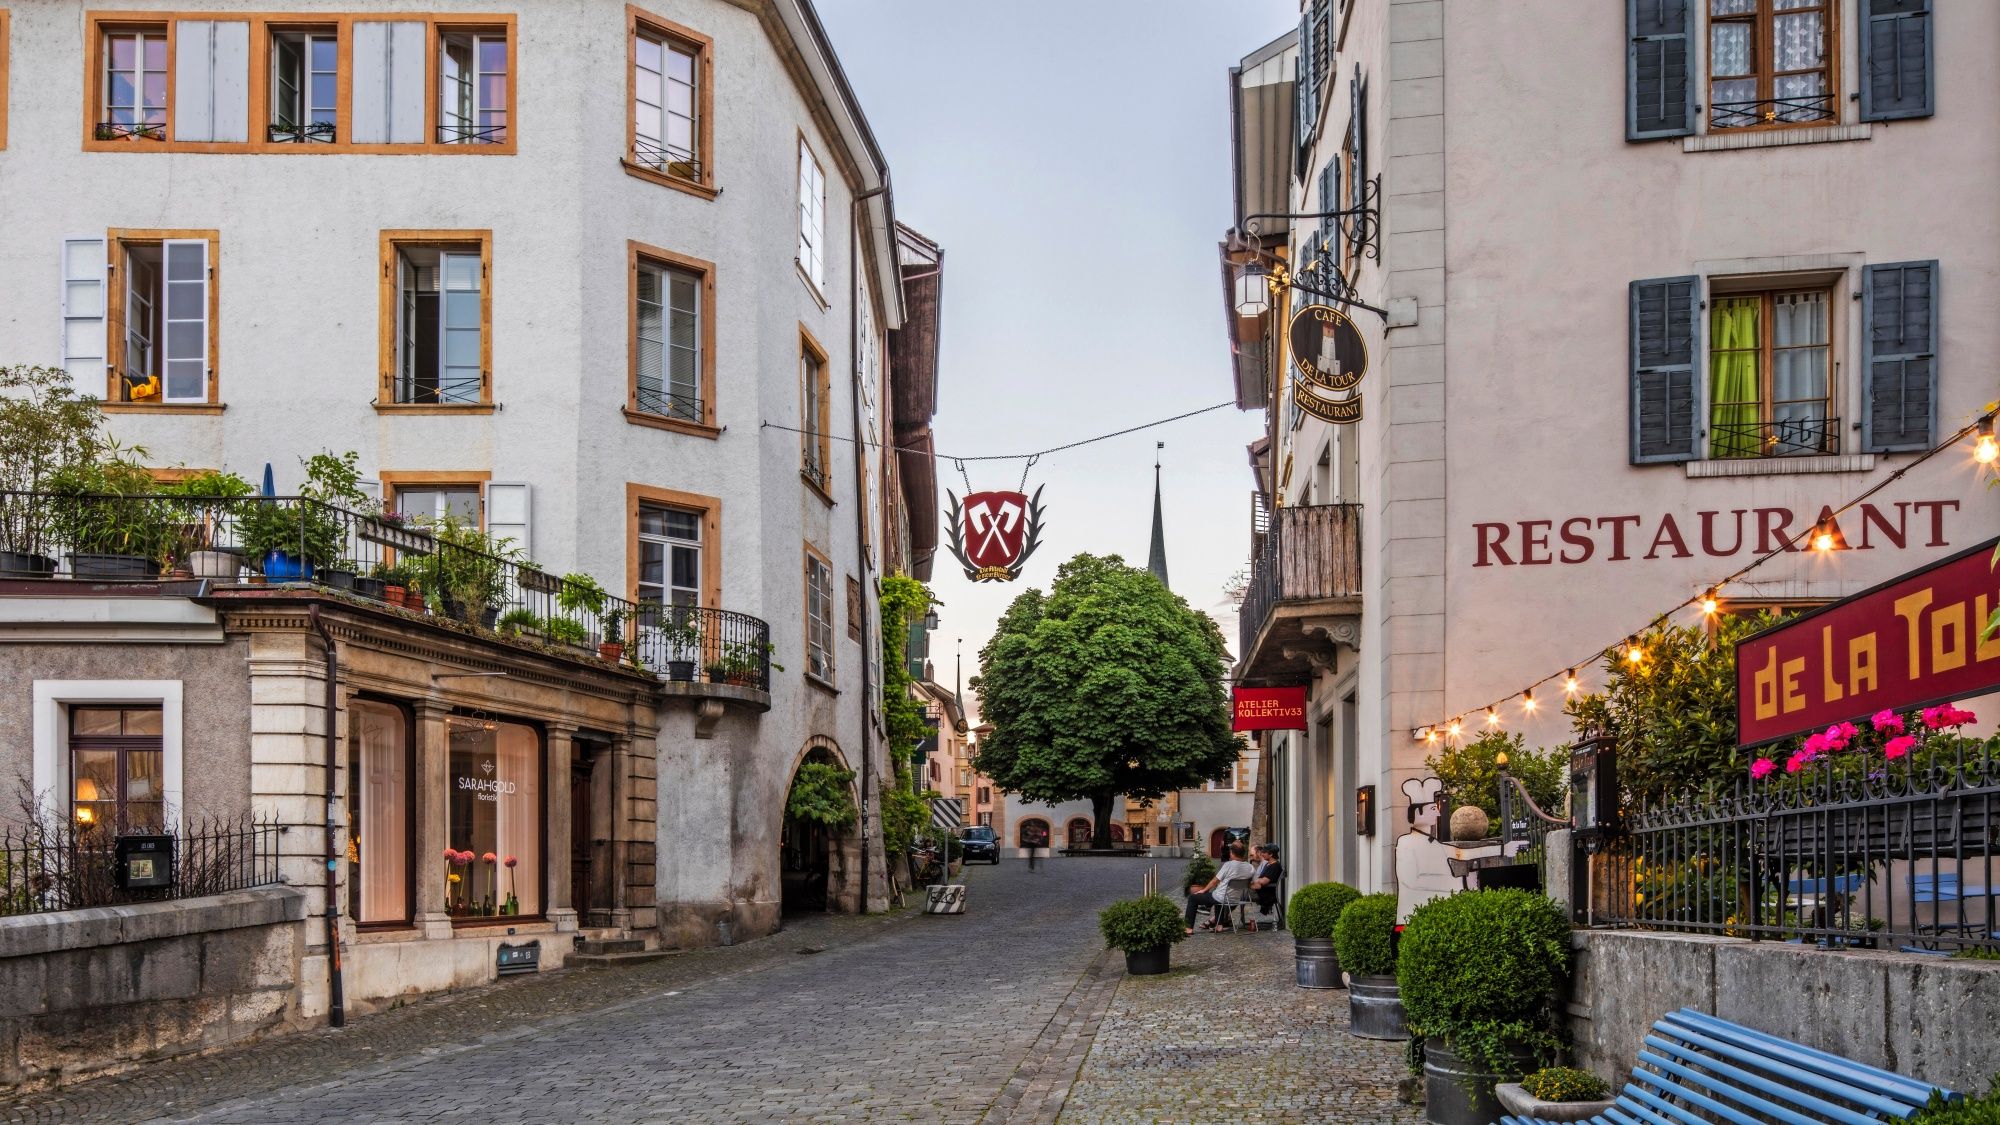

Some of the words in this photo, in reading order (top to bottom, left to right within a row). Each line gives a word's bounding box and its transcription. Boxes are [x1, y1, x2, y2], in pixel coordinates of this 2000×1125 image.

[1314, 309, 1342, 326] CAFE
[1301, 358, 1314, 376] DE
[1314, 369, 1327, 385] LA
[1328, 371, 1356, 388] TOUR
[1297, 391, 1359, 418] RESTAURANT
[1472, 499, 1960, 567] RESTAURANT
[1238, 700, 1279, 709] ATELIER
[1238, 708, 1302, 718] KOLLEKTIV33
[458, 777, 515, 793] SARAHGOLD
